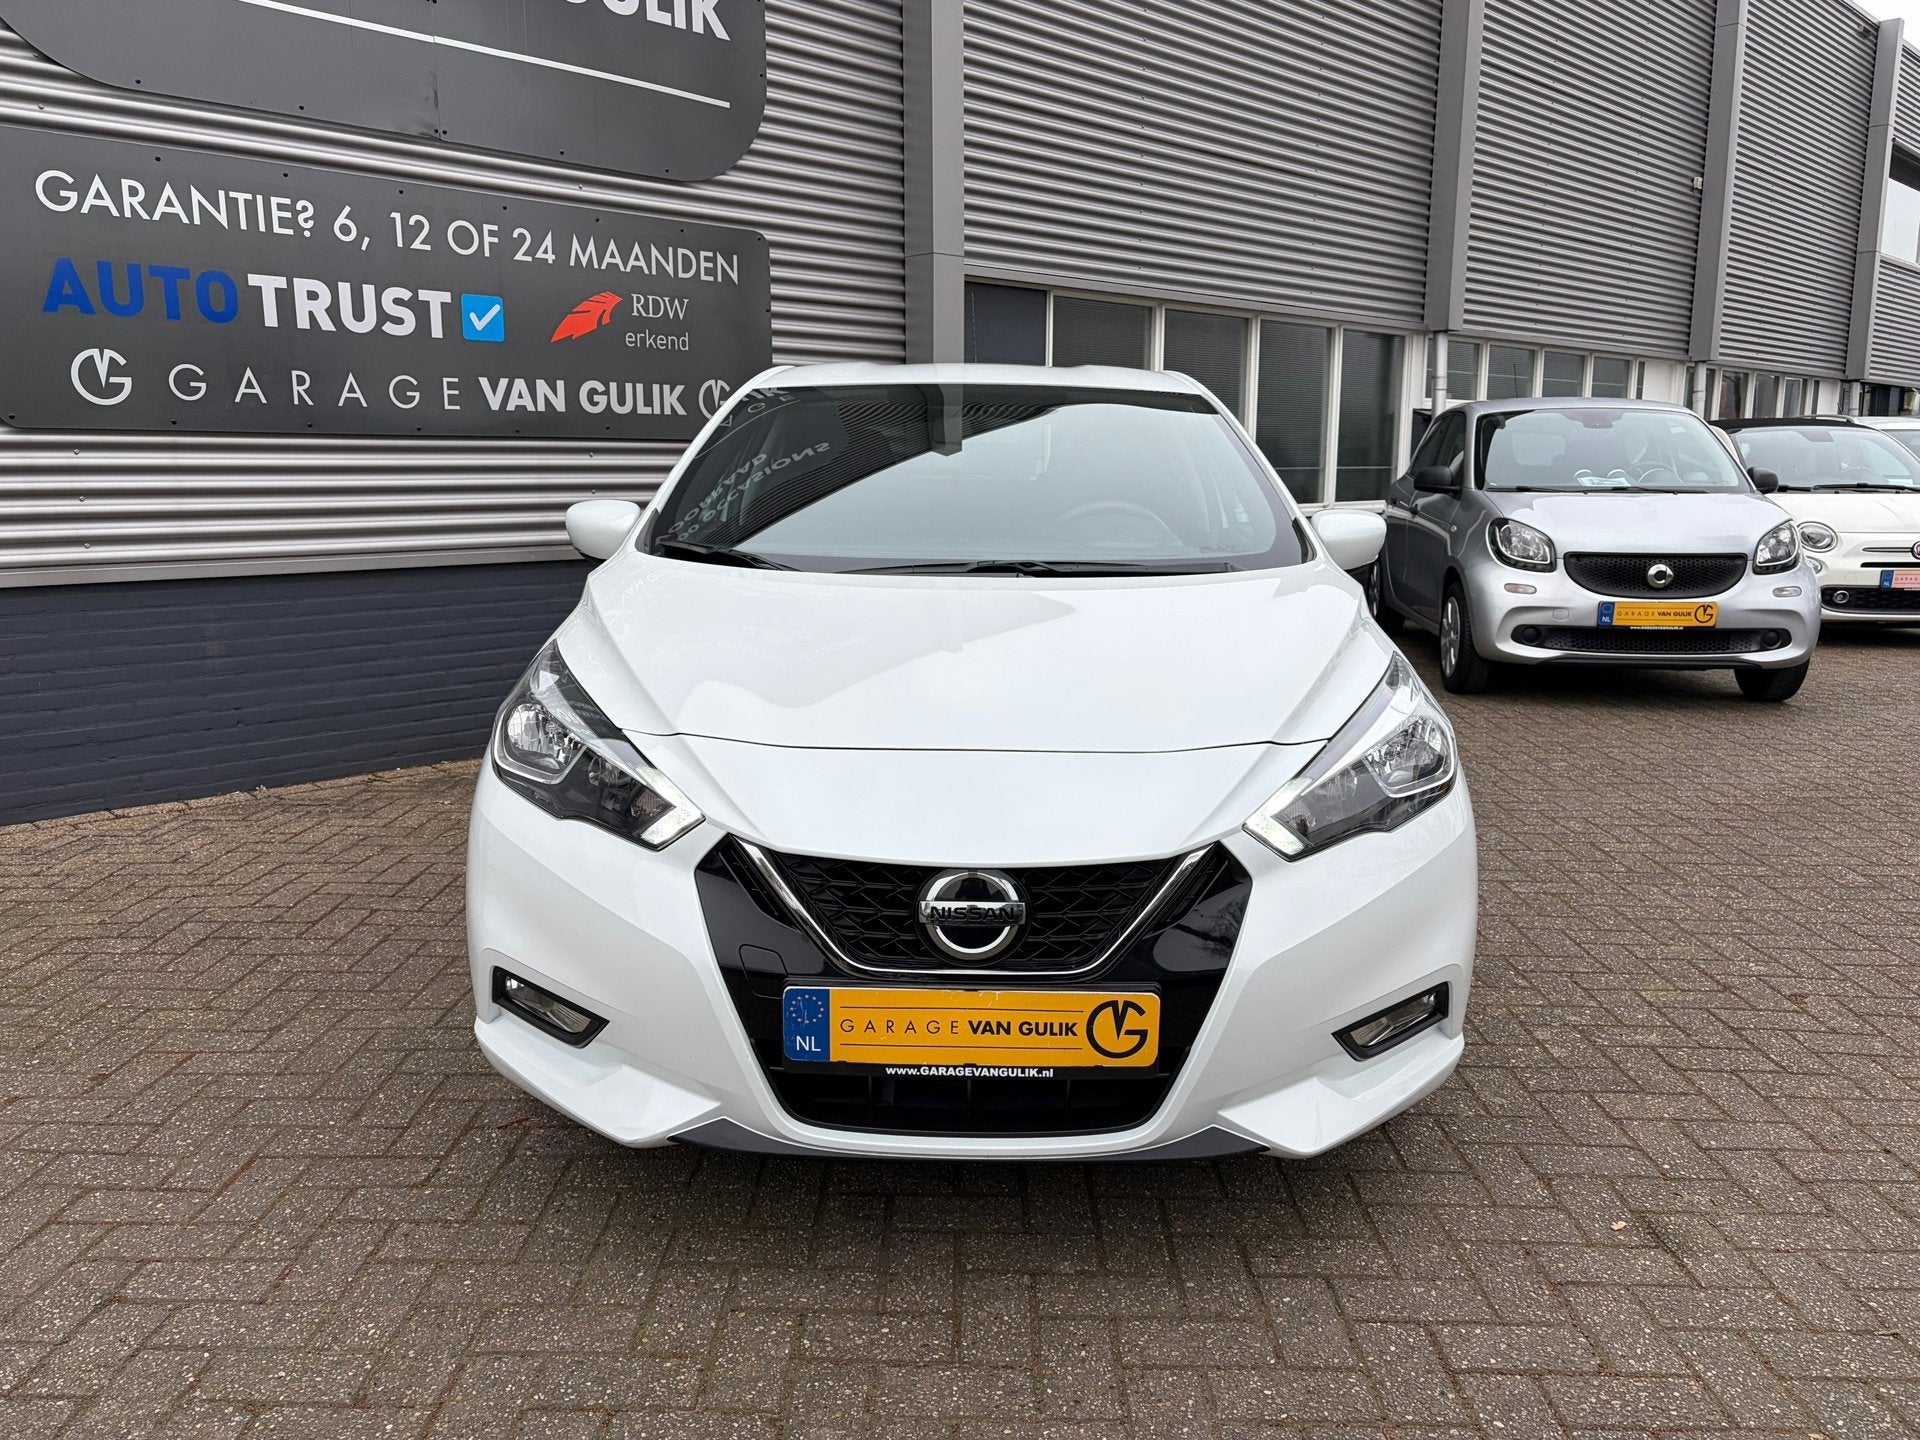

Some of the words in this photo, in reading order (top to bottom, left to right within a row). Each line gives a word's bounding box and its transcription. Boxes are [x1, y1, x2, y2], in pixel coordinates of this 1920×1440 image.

[565, 0, 732, 41] LIK
[35, 170, 315, 238] GARANTIE?
[333, 205, 371, 251] 6,
[390, 212, 432, 251] 12
[447, 220, 500, 257] OF
[512, 228, 556, 264] 24
[569, 233, 739, 285] MAANDEN
[631, 293, 690, 320] RDW
[624, 329, 690, 351] erkend
[168, 363, 461, 411] GARAGE
[478, 376, 566, 413] VAN
[578, 380, 688, 416] GULIK
[929, 905, 1016, 923] NISSAN
[839, 1017, 959, 1035] GARAGE
[967, 1019, 1012, 1036] VAN
[1018, 1020, 1079, 1037] GULIK
[796, 1034, 821, 1052] NL
[885, 1065, 1054, 1078] www.GARAGEVANGULIK.nl
